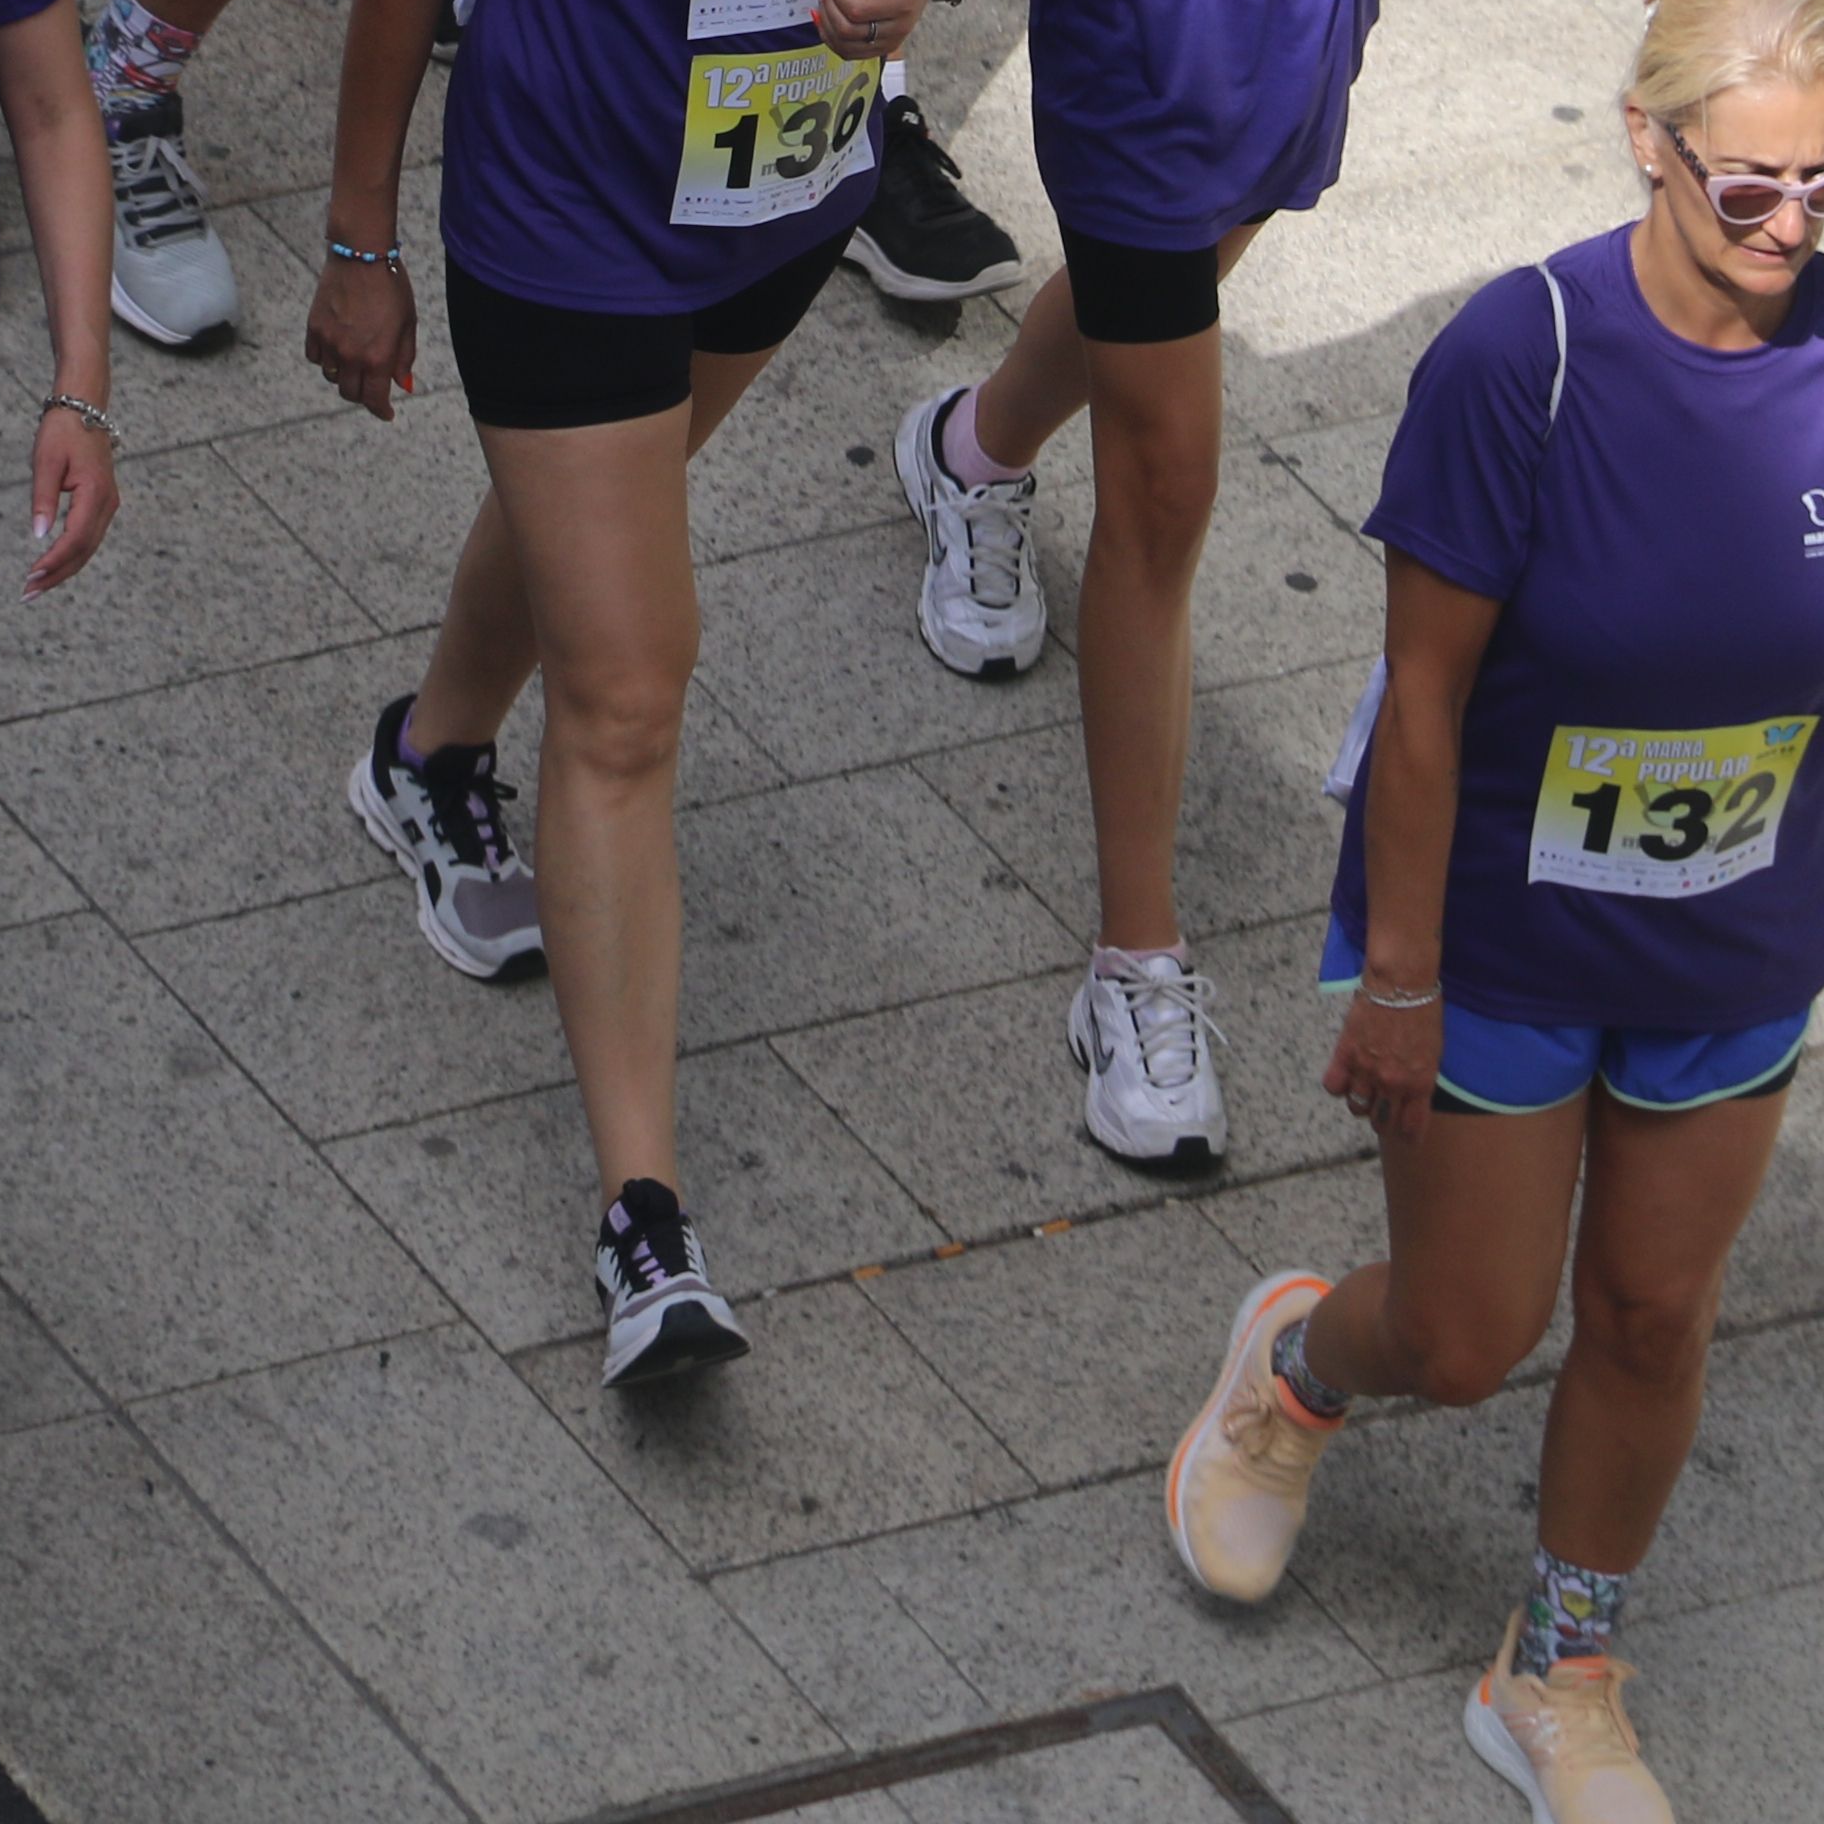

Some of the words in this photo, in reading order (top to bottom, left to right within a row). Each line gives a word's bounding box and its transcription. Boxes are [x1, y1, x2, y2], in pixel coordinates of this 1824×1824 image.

[776, 54, 828, 80] MARXA
[714, 72, 869, 189] 136
[1642, 738, 1705, 759] MARXA
[1638, 755, 1750, 783] POPULAR
[1571, 770, 1776, 862] 132
